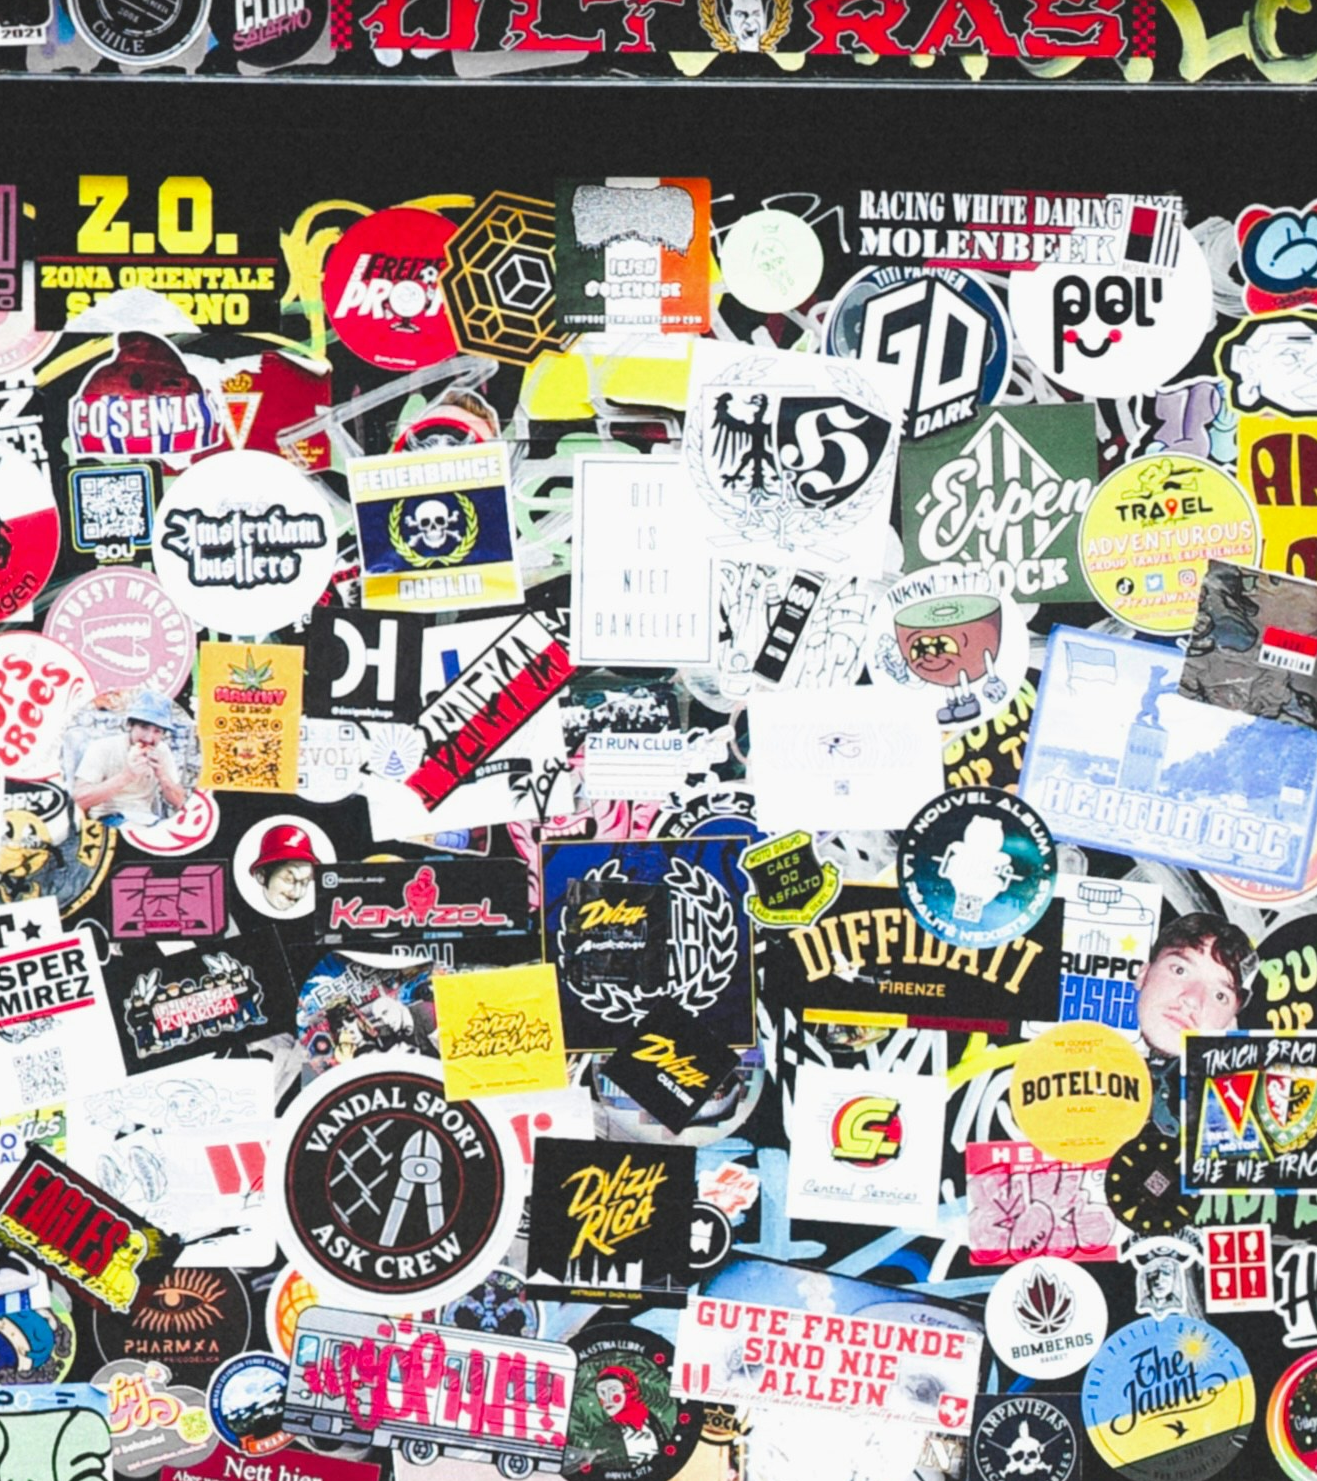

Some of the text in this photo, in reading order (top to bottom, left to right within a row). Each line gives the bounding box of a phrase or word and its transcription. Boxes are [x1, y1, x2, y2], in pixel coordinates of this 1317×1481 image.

[91, 20, 148, 56] CHILE
[76, 174, 239, 254] Z.O.
[859, 190, 1123, 229] RACING WHITE DARING
[41, 265, 274, 291] ZONA ORIENTALE
[589, 735, 683, 752] Z1 RUN CLUB
[878, 982, 946, 998] FIRENZE
[1021, 1069, 1141, 1108] BOTELLON
[696, 1301, 966, 1362] GUTE FREUNDE
[742, 1336, 899, 1383] SIND NIE
[758, 1369, 889, 1407] ALLEIN
